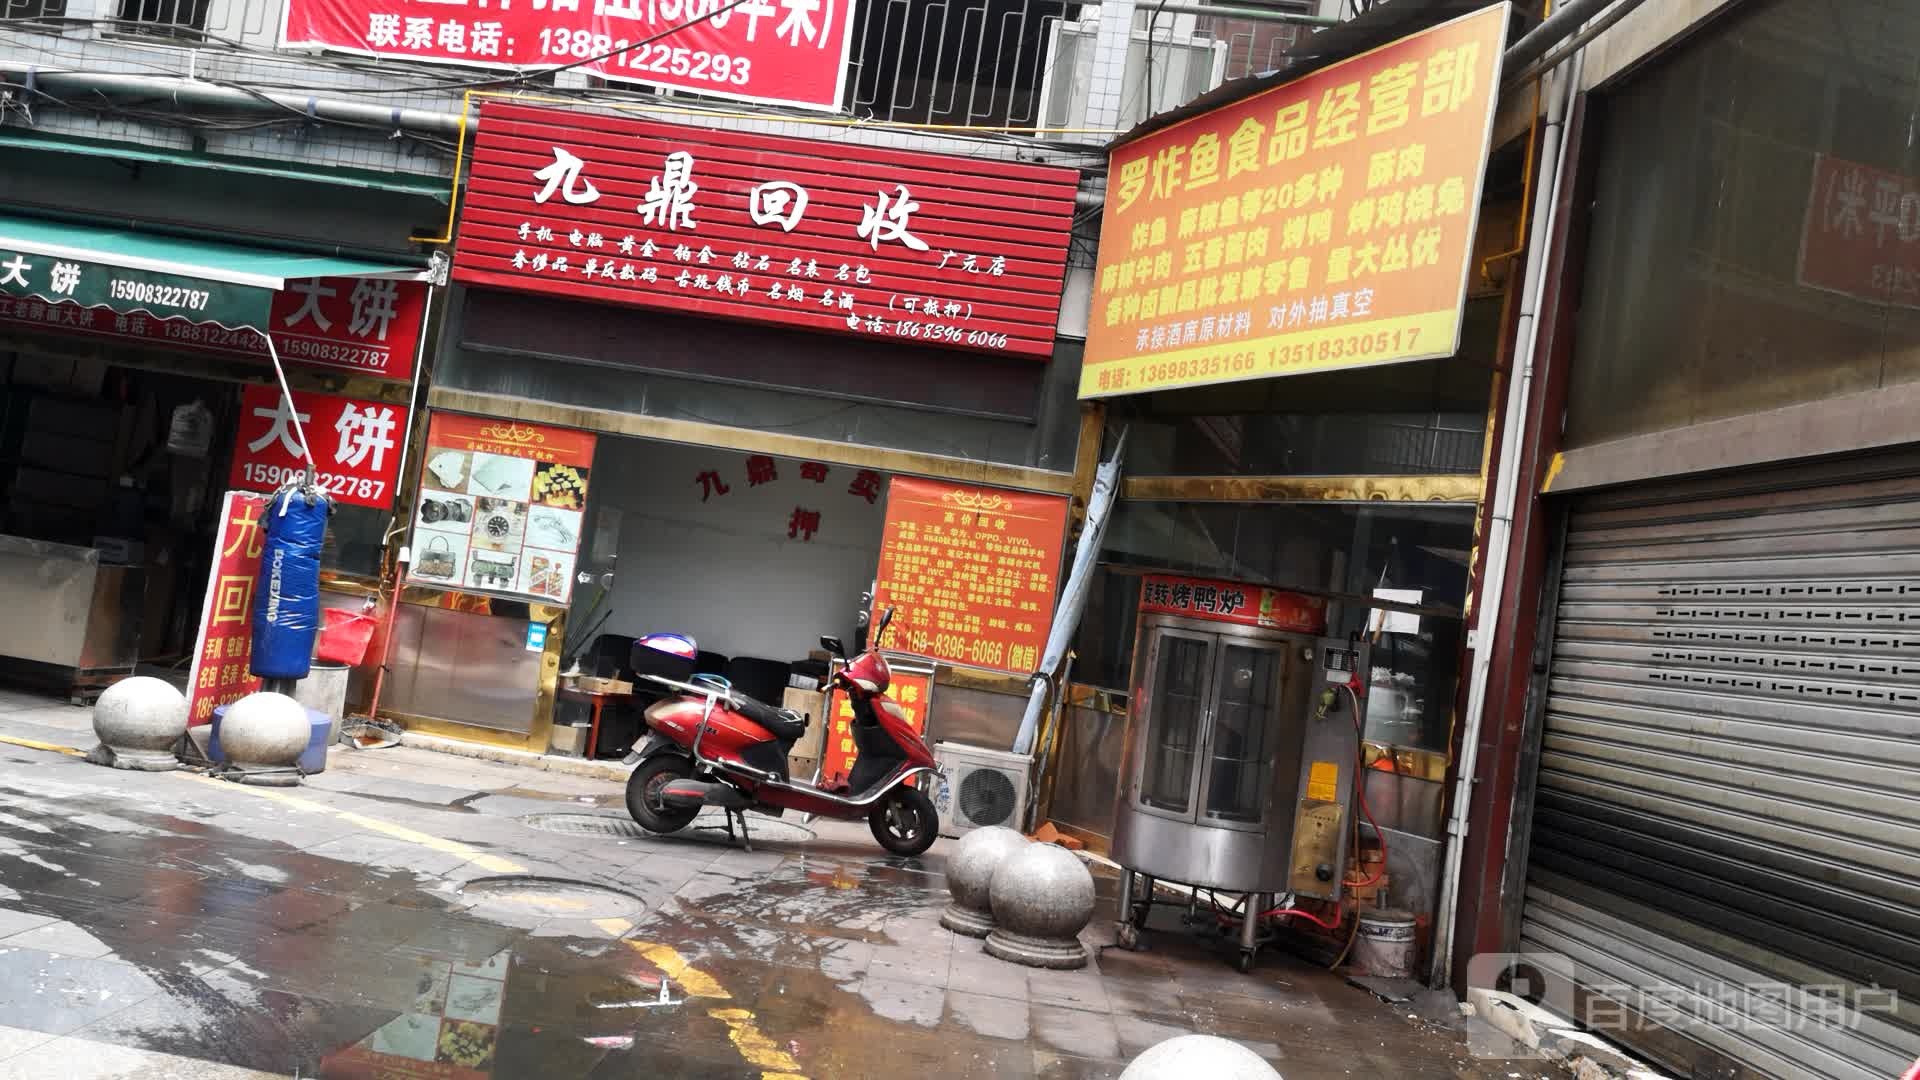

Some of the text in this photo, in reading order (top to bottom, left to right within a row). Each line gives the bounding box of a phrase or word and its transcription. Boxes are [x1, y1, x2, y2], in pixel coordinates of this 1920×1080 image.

[366, 13, 752, 85] 联系电话： 13881225293
[1116, 42, 1480, 215] 罗炸鱼食品经营部
[533, 146, 930, 252] 九鼎回收
[517, 222, 873, 285] 手机 电脑 黄金 铂金 钻石 名表 名包
[1132, 217, 1167, 251] 炸鱼
[2, 255, 210, 312] 大饼 15908322787
[511, 249, 973, 321] 奢侈品 单反数码 古玩钱币 名烟 名酒 (可抵押)
[937, 249, 1007, 278] 广元店
[284, 277, 398, 342] 大饼
[1136, 287, 1375, 352] 承接酒席原材料 对外抽真空
[283, 339, 390, 368] 15908322787
[1139, 351, 1257, 385] 13698335166
[1267, 327, 1421, 368] 13518330517
[247, 393, 396, 472] 大饼
[212, 575, 254, 627] 回
[205, 637, 223, 660] 手机
[905, 629, 1003, 666] 186-8396-6066
[199, 665, 218, 689] 名包
